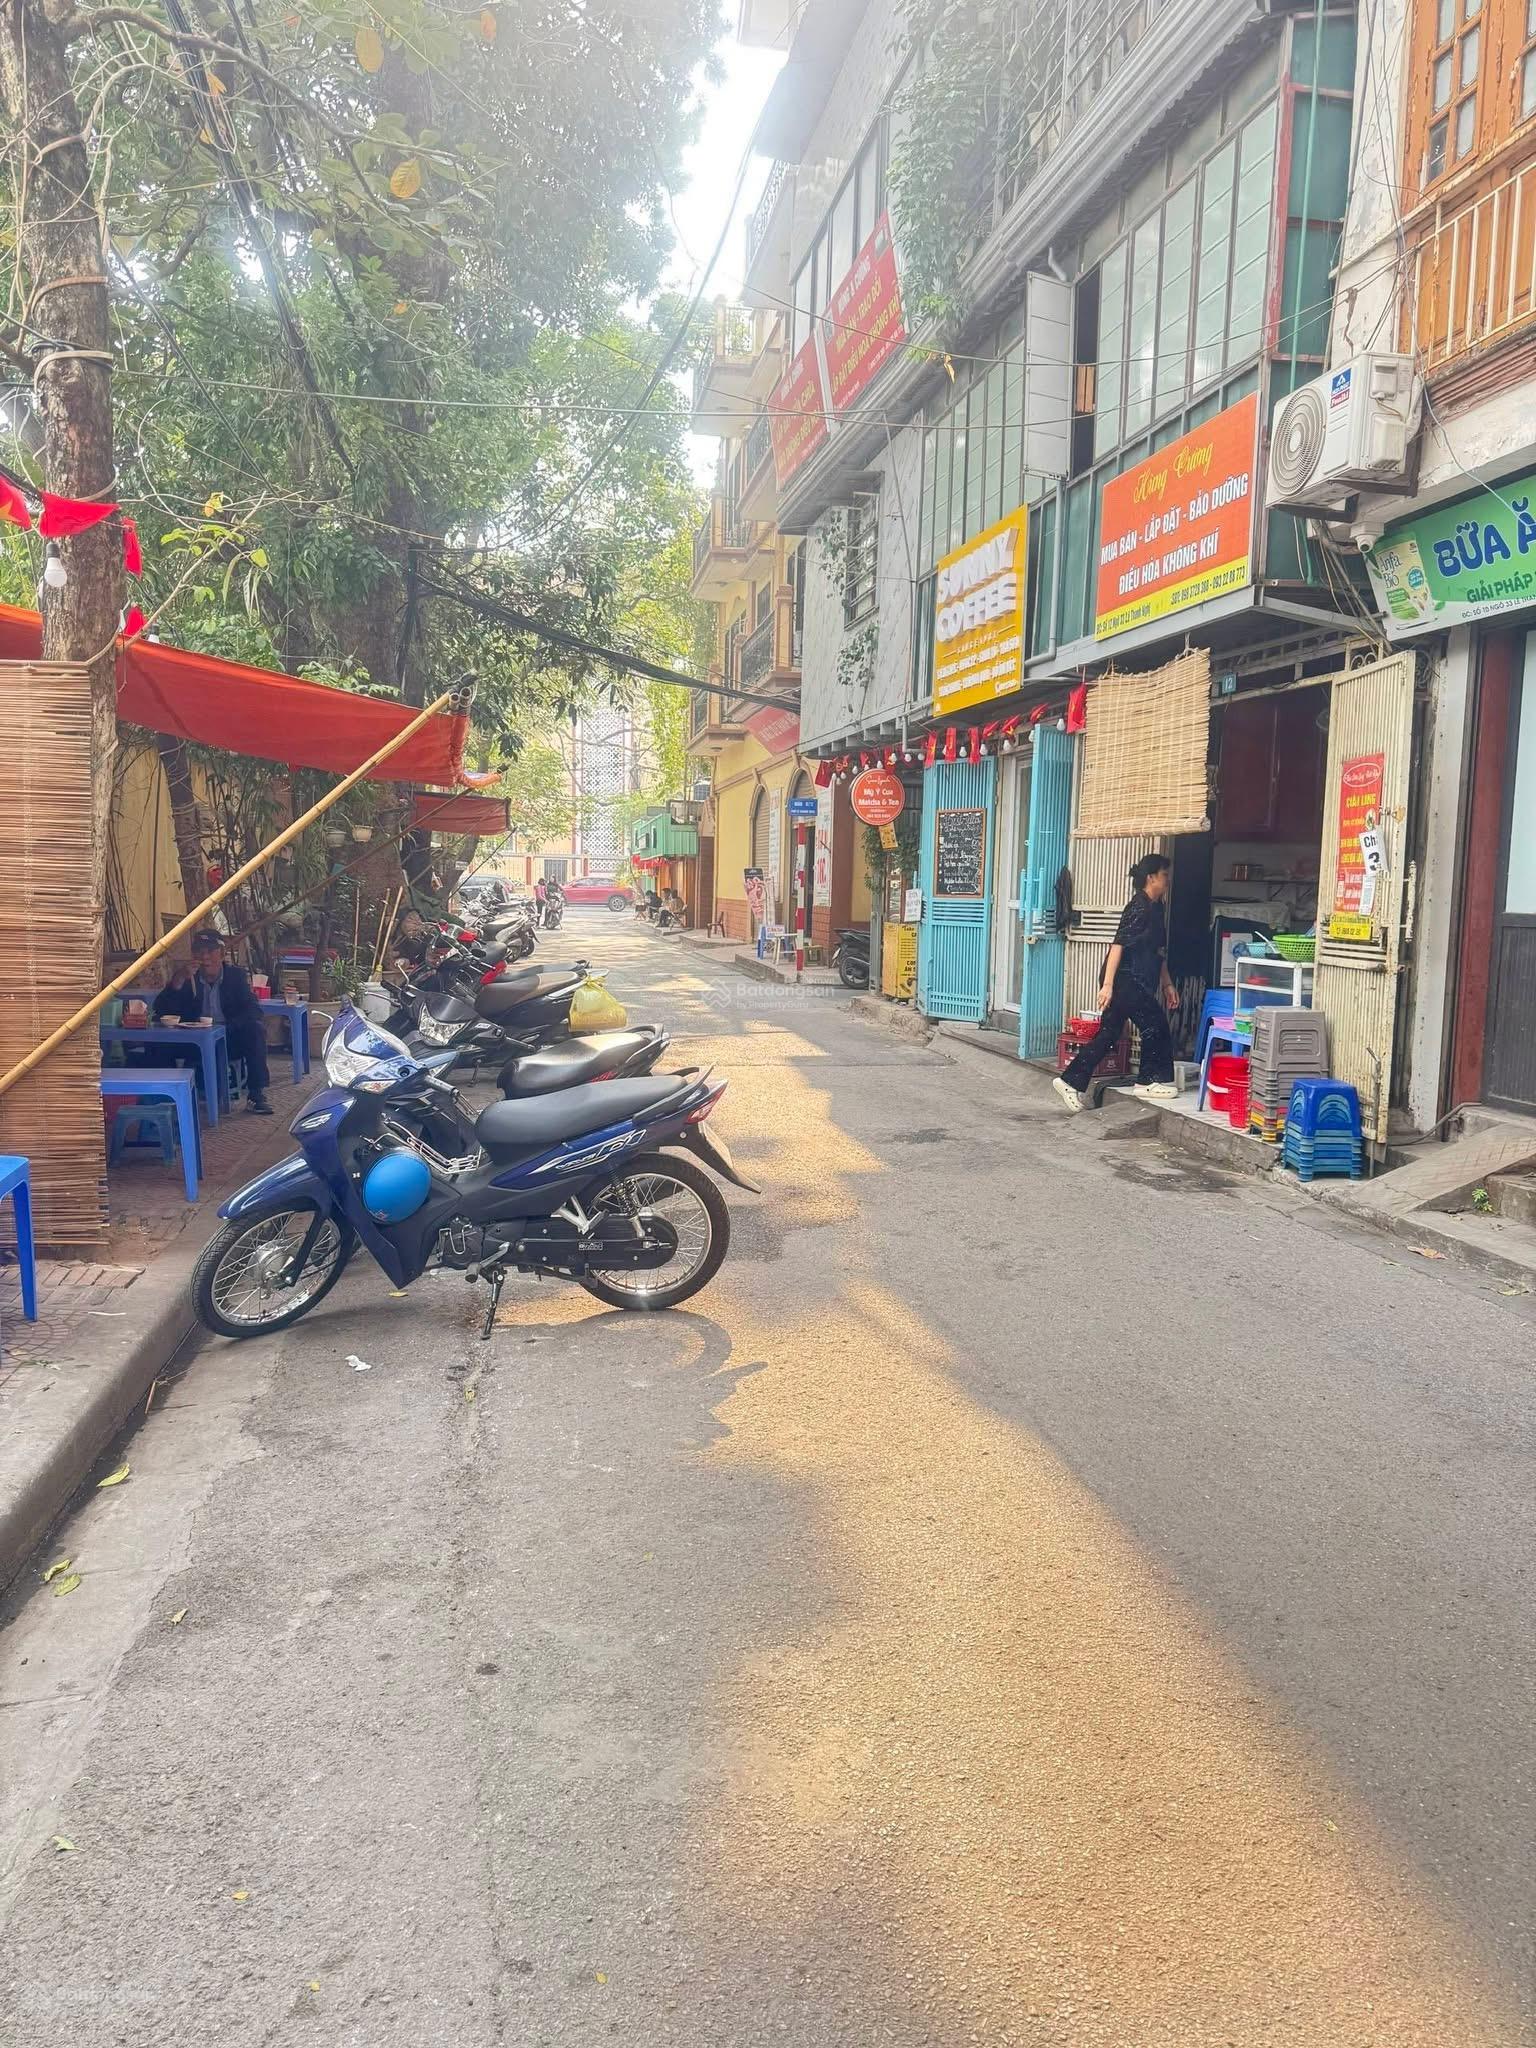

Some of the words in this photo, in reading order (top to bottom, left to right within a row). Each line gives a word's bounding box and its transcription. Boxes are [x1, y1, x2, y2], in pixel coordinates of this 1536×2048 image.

[1100, 541, 1117, 565] MUA
[1119, 531, 1137, 556] BÁN
[1144, 515, 1160, 543] LẮP
[1163, 506, 1182, 535] ĐẶT
[1189, 489, 1209, 522] BẢO
[1211, 473, 1248, 509] DƯỠNG
[938, 528, 1018, 604] SUNNY
[1119, 563, 1140, 595] ĐIỀU
[1142, 555, 1160, 585] HÒA
[1163, 542, 1198, 576] KHÔNG
[1200, 528, 1220, 560] KHÍ
[1433, 520, 1511, 577] BỮA
[1467, 578, 1494, 604] GIẢI
[1495, 571, 1533, 596] PHÁP
[1473, 606, 1481, 615] SỐ
[1225, 678, 1233, 691] 12
[1363, 835, 1376, 848] Ch
